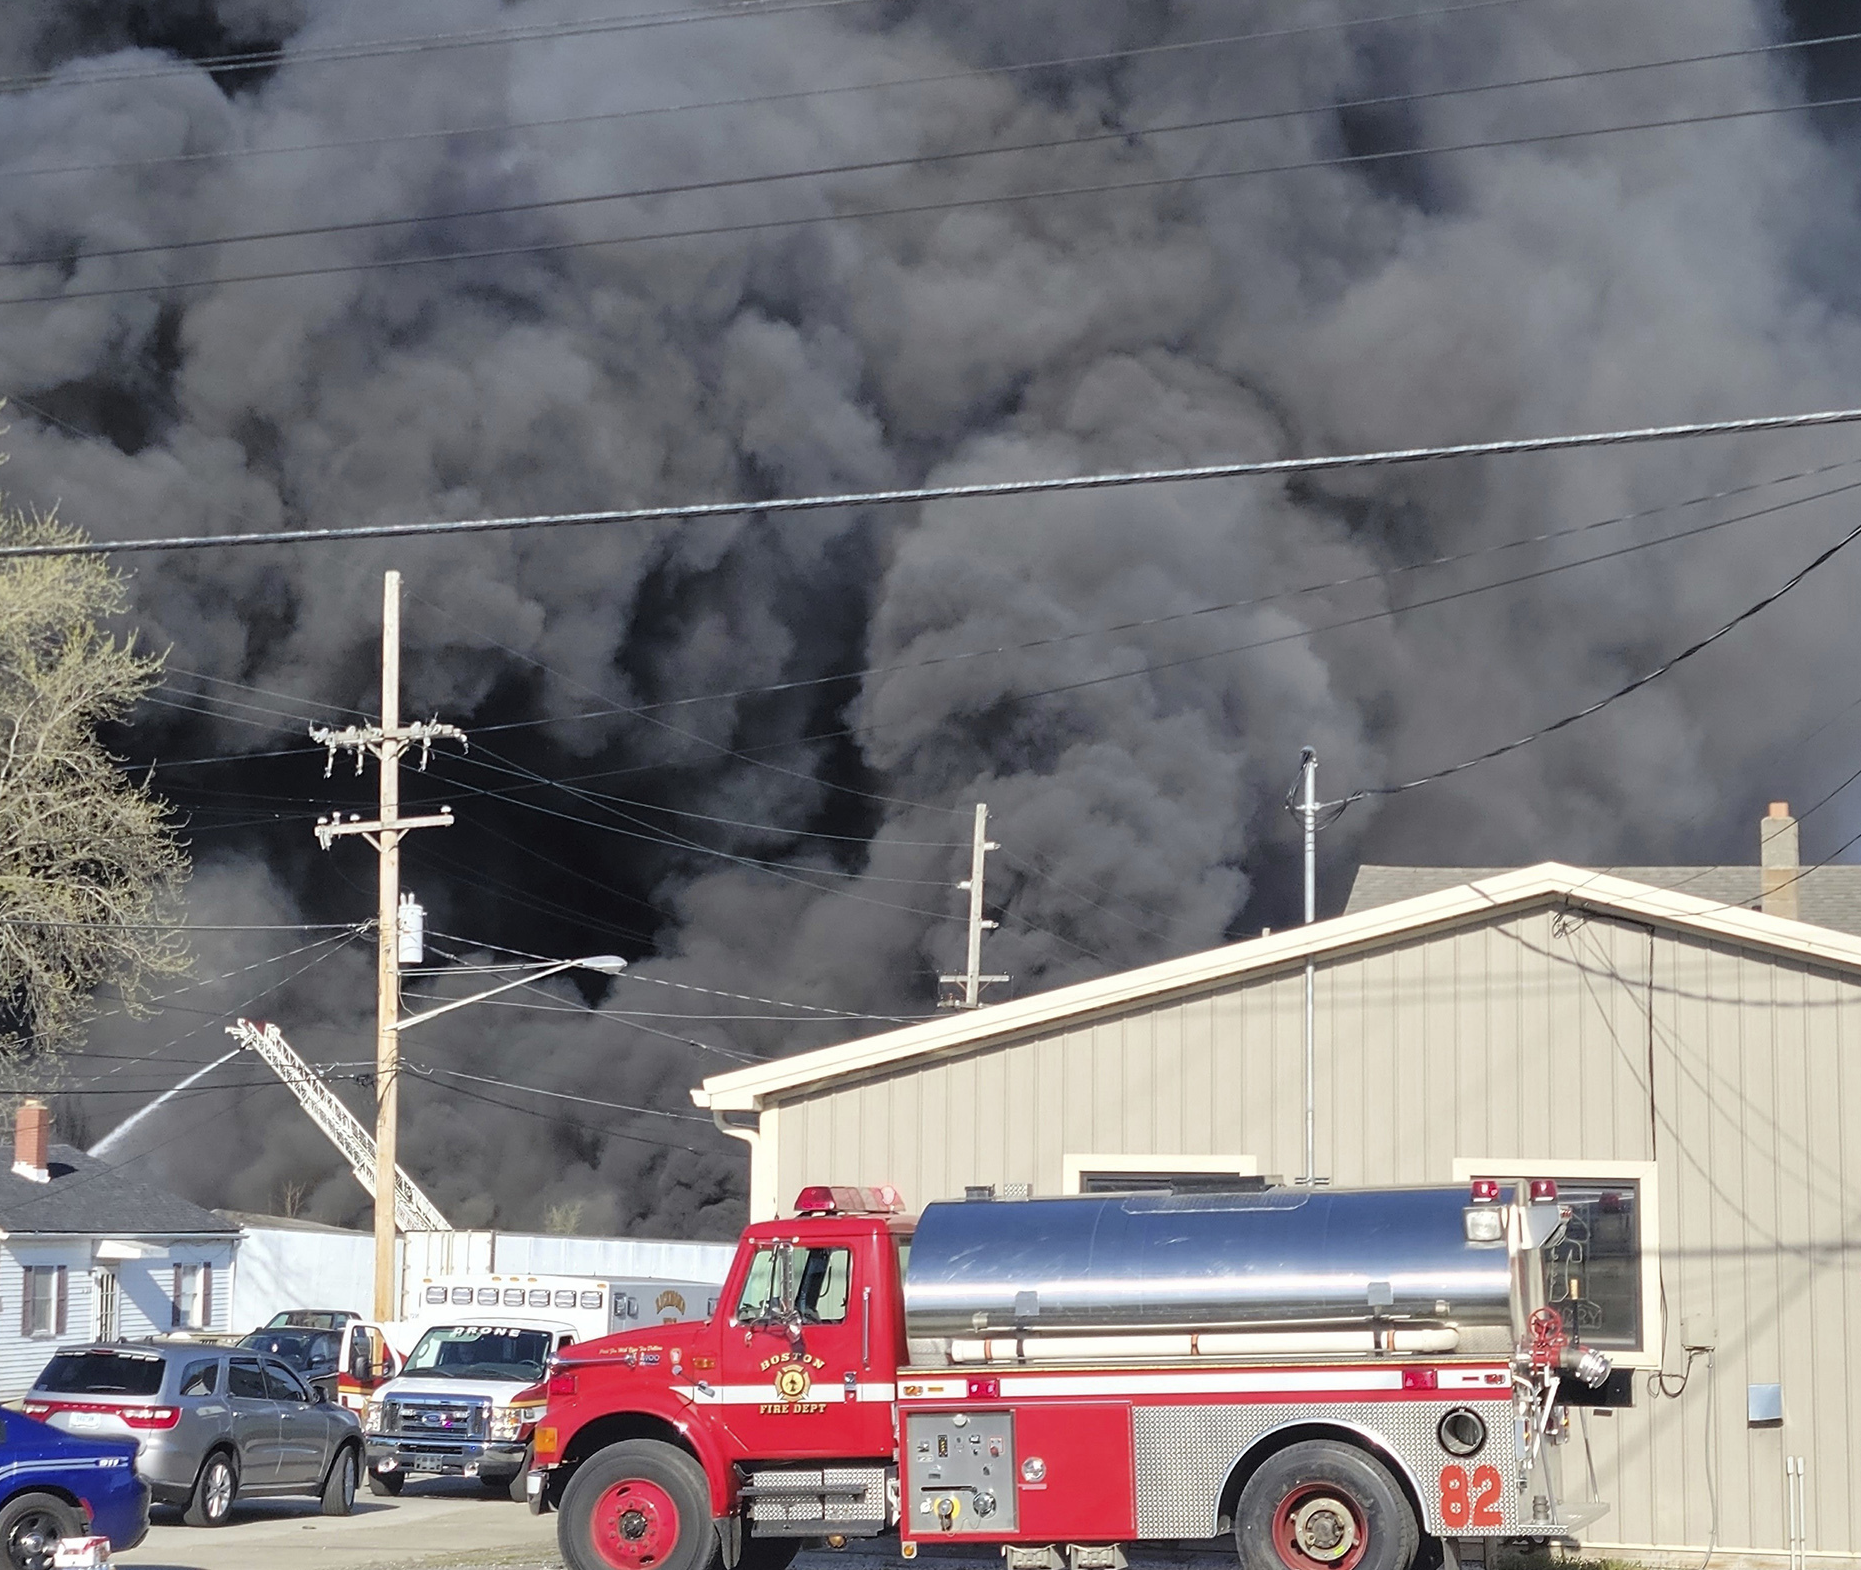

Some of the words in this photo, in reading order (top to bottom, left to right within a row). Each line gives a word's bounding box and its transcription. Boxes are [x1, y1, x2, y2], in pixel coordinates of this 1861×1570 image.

[760, 1352, 825, 1371] BOSTON
[759, 1404, 789, 1414] FIRE
[793, 1403, 826, 1413] DEPT
[1440, 1464, 1504, 1528] 82
